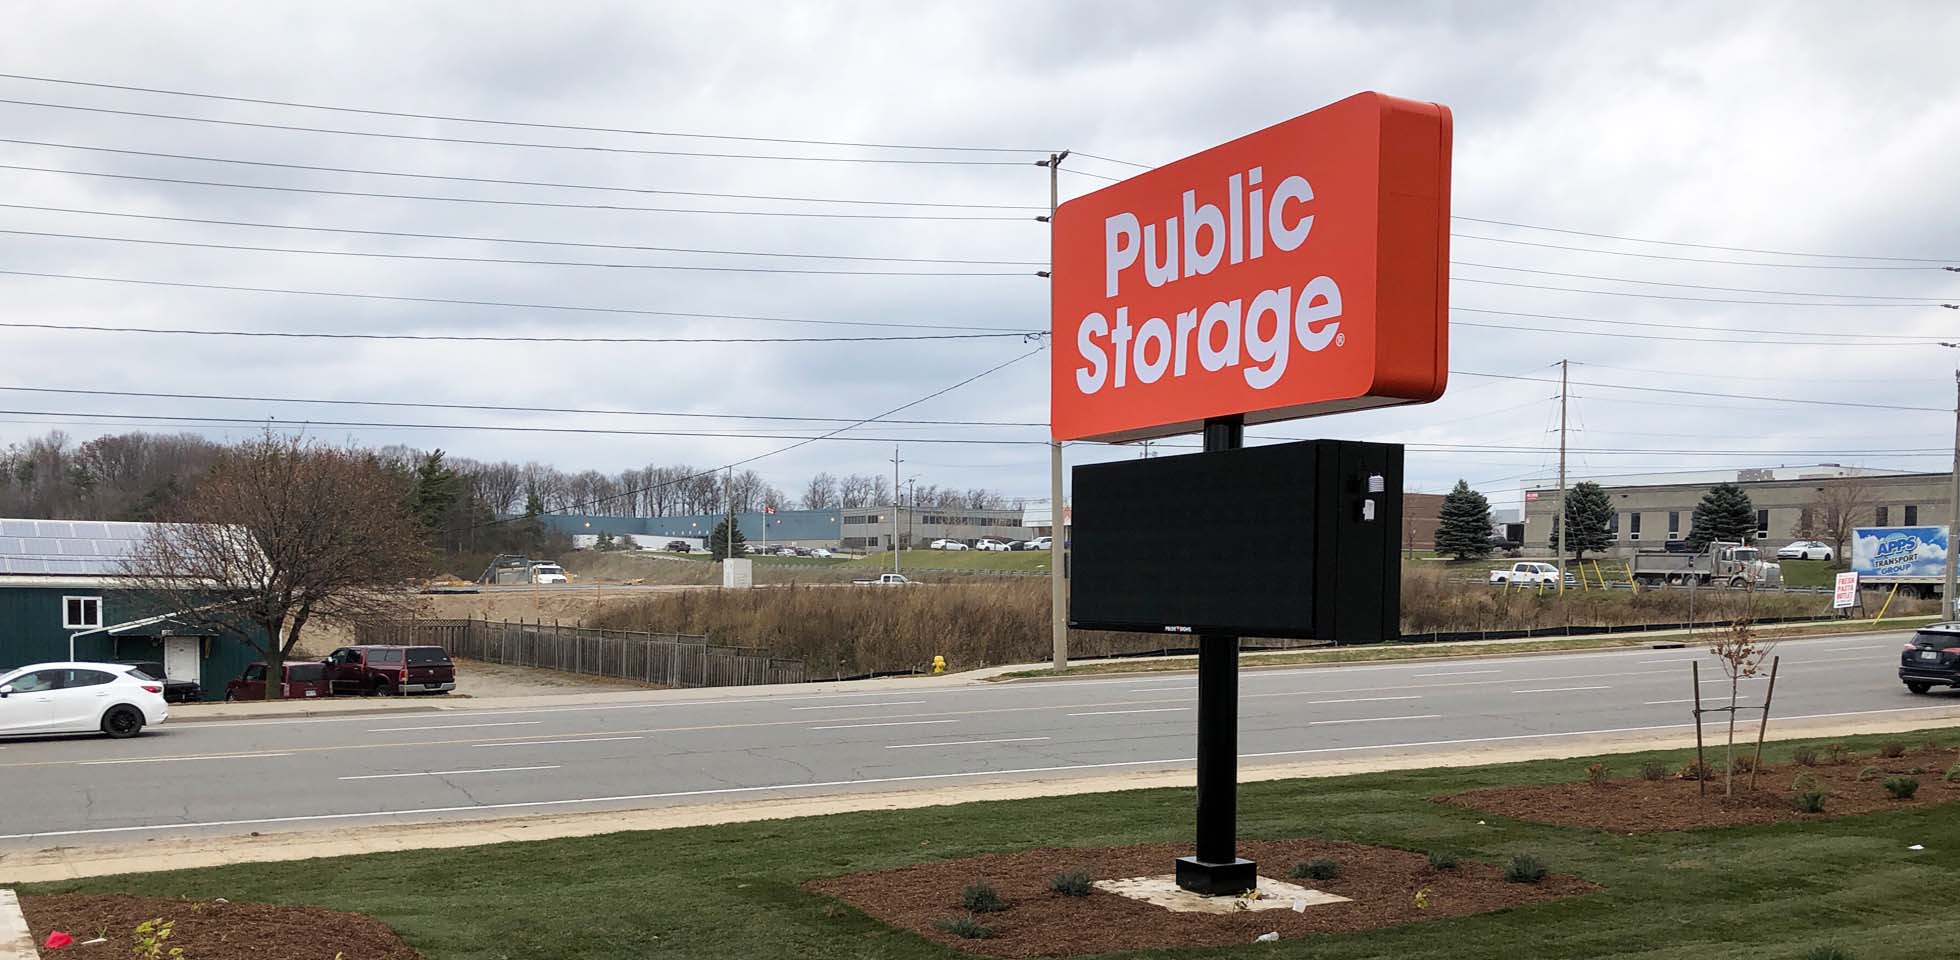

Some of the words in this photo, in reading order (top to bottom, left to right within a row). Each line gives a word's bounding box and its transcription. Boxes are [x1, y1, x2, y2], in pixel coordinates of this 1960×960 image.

[1105, 166, 1314, 298] Public
[1877, 537, 1916, 555] APPS
[1875, 554, 1918, 567] TRANSPORT
[1881, 563, 1911, 575] GROUP
